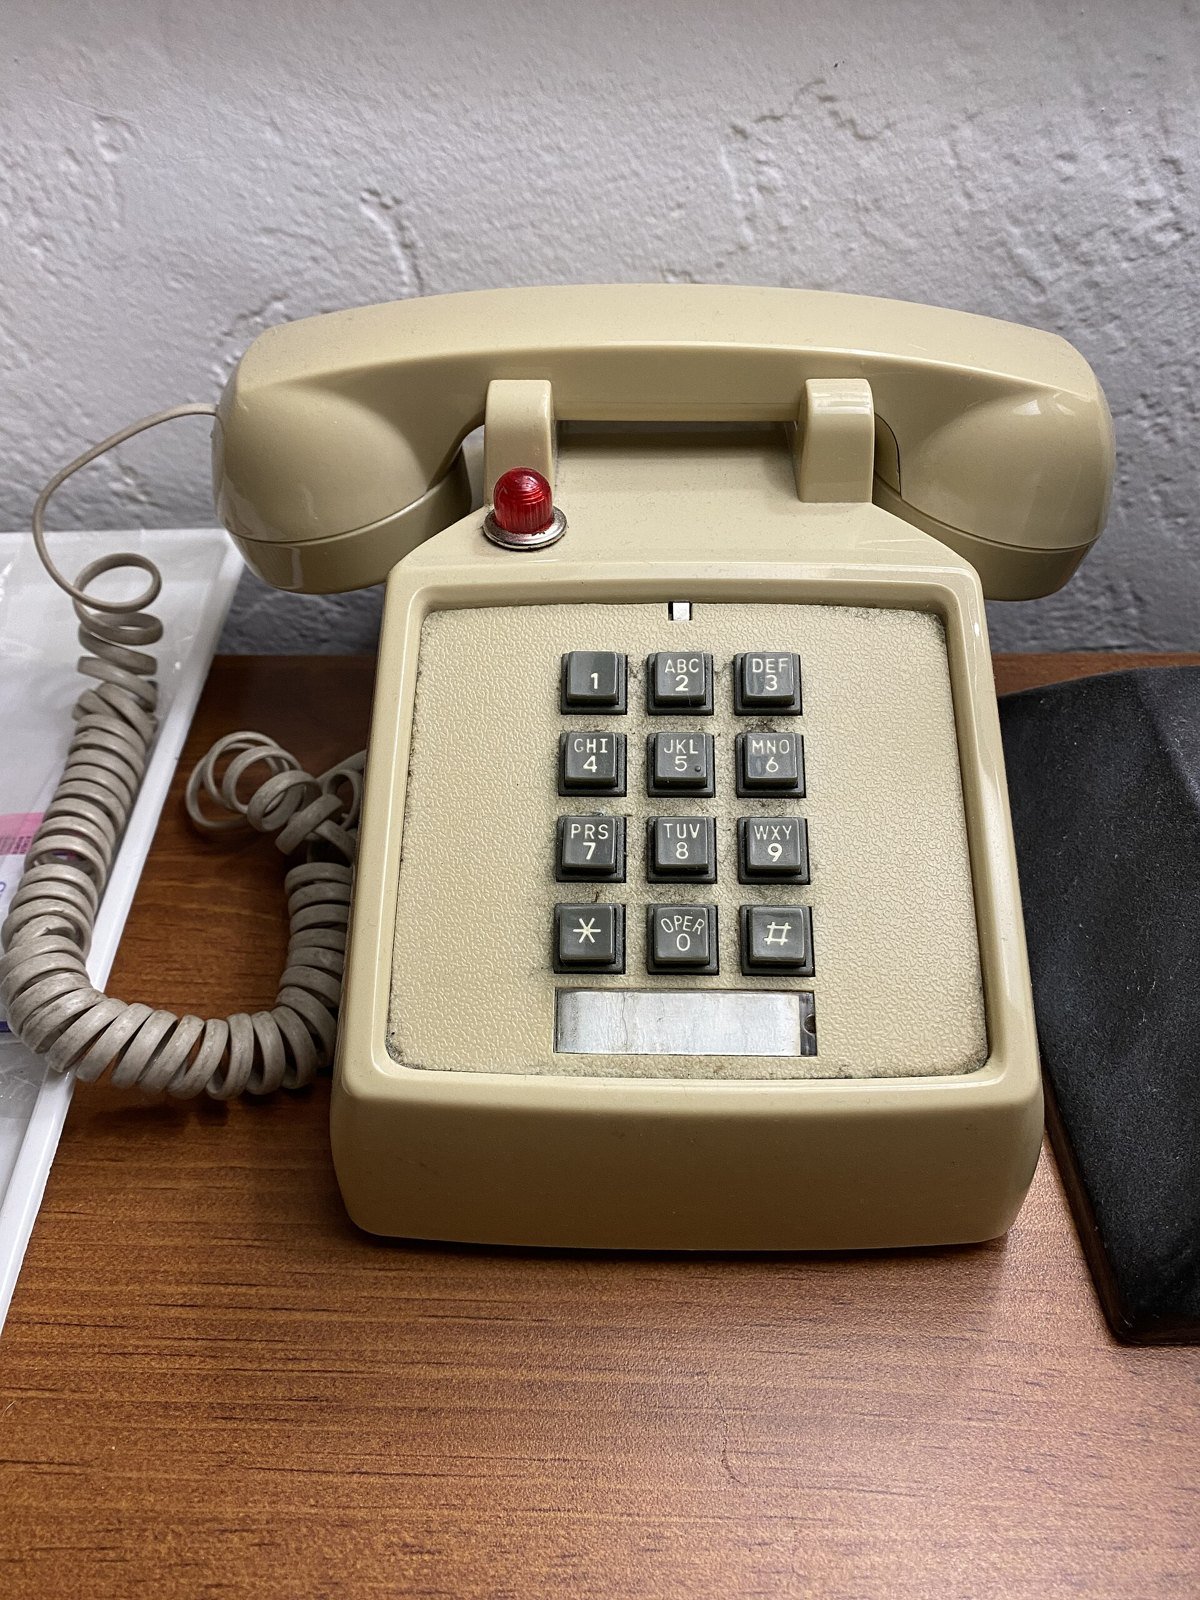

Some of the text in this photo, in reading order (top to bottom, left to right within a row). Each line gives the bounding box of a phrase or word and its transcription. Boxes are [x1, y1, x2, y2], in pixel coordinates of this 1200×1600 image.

[664, 658, 700, 674] ABC
[751, 657, 789, 673] DEF
[590, 672, 599, 690] 1
[675, 674, 689, 692] 2
[764, 675, 778, 692] 3
[573, 738, 608, 753] GHI
[663, 739, 698, 754] JKL
[751, 739, 790, 755] MNO
[582, 755, 598, 773] 4
[674, 755, 688, 772] 5
[765, 756, 779, 773] 6
[570, 823, 609, 840] PRS
[663, 823, 700, 840] TUV
[753, 825, 793, 841] WXY
[582, 841, 596, 860] 7
[675, 841, 689, 860] 8
[767, 842, 783, 863] 9
[660, 915, 706, 936] OPER
[763, 921, 792, 946] #
[676, 933, 691, 952] 0
